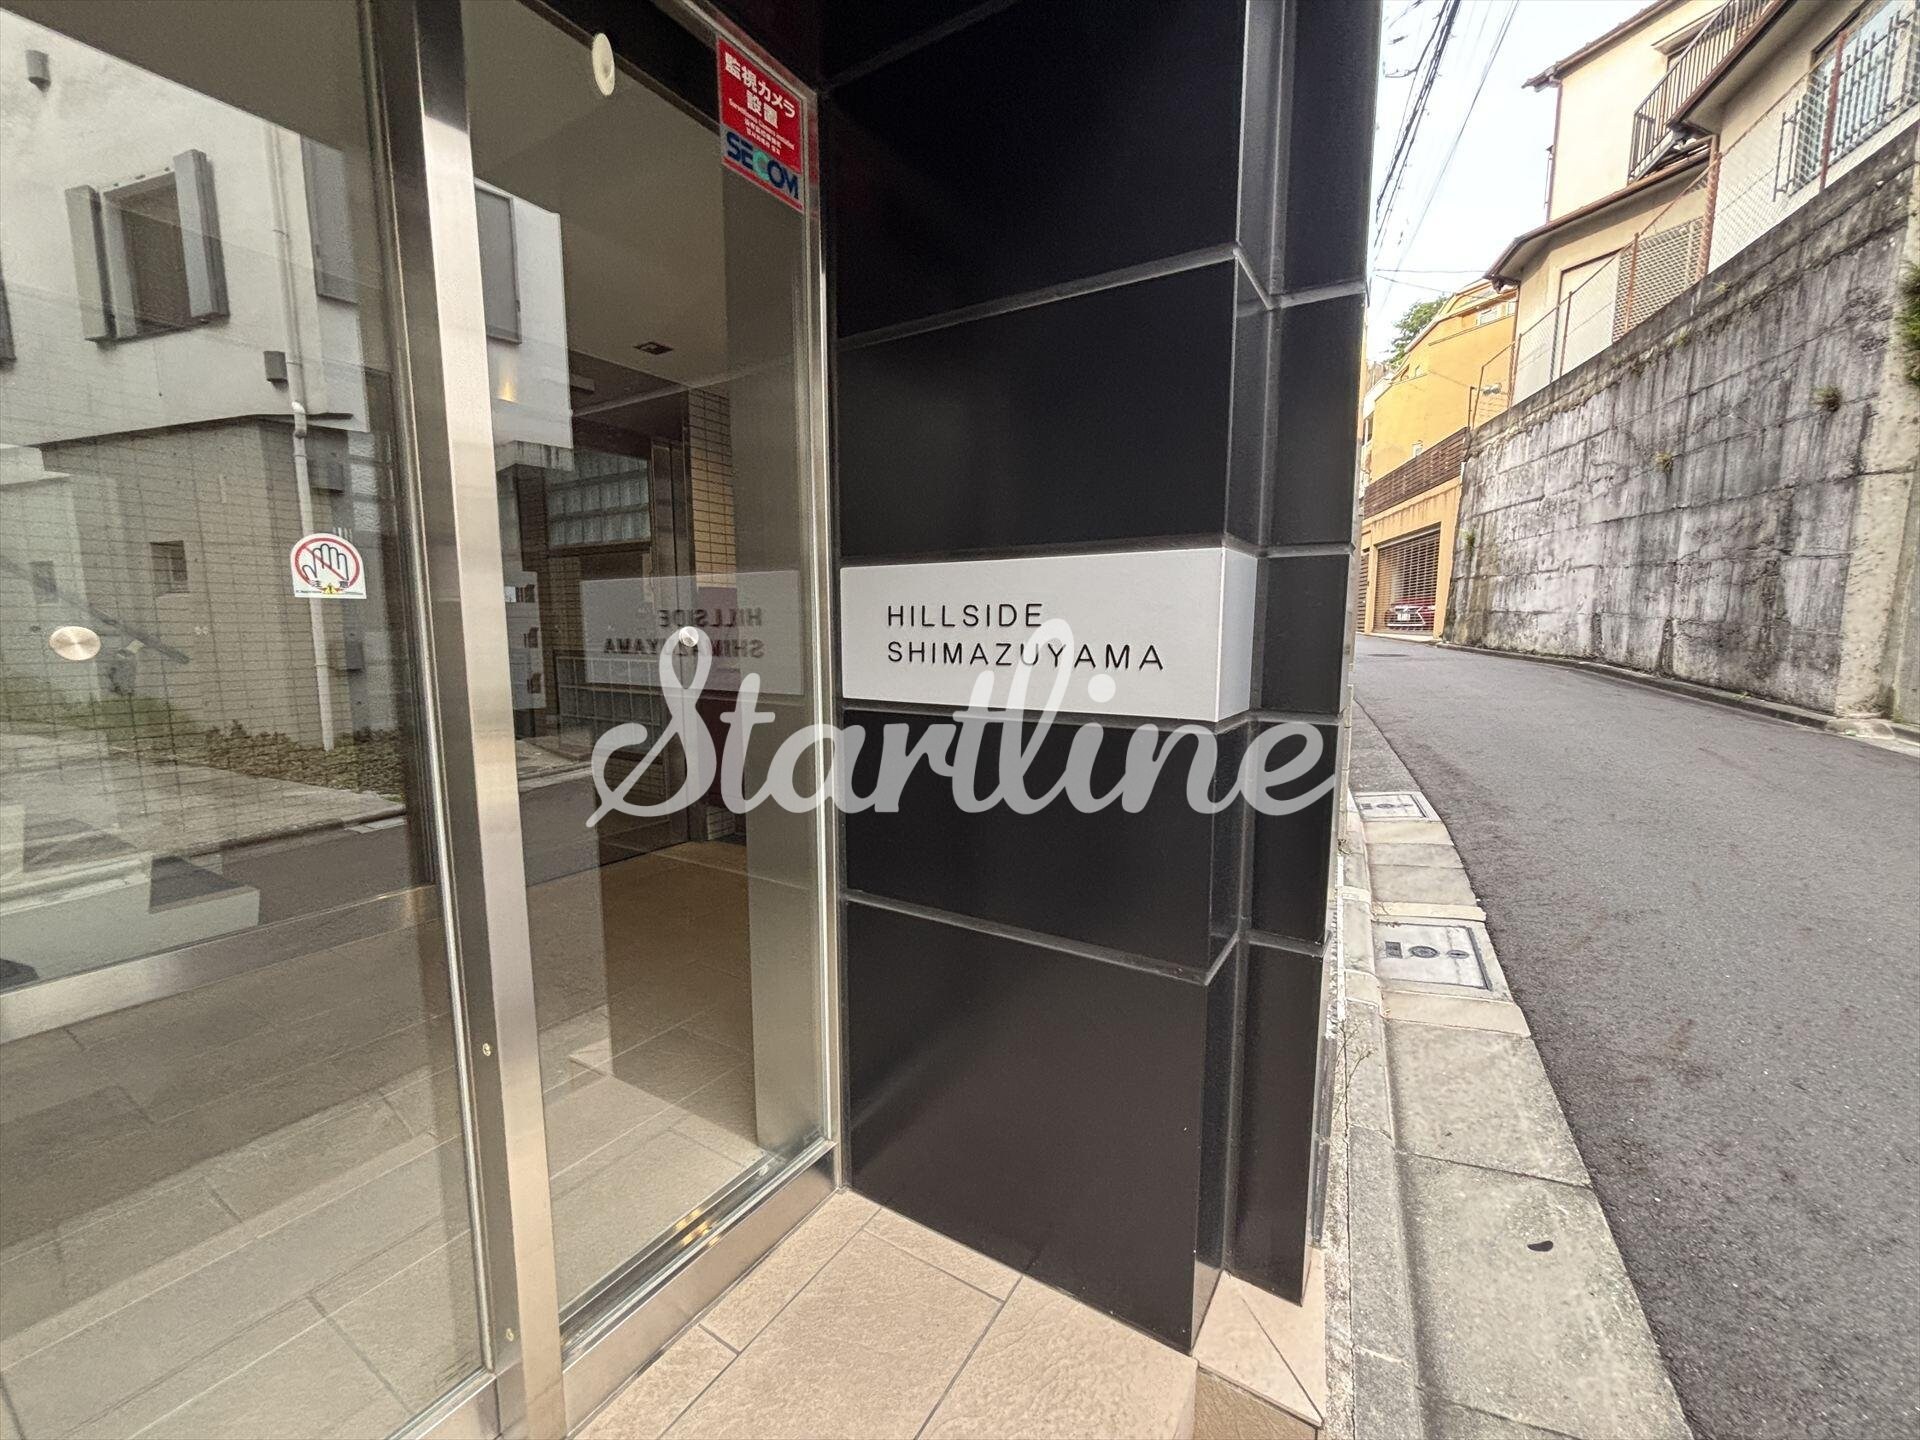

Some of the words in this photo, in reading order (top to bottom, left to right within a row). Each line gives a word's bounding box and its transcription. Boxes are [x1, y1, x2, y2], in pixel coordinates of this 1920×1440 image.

[725, 51, 796, 118] 監視カメラ
[726, 131, 799, 199] SECOM
[887, 603, 1043, 627] HILLSIDE
[887, 640, 1164, 671] SHIMAZUYAMA
